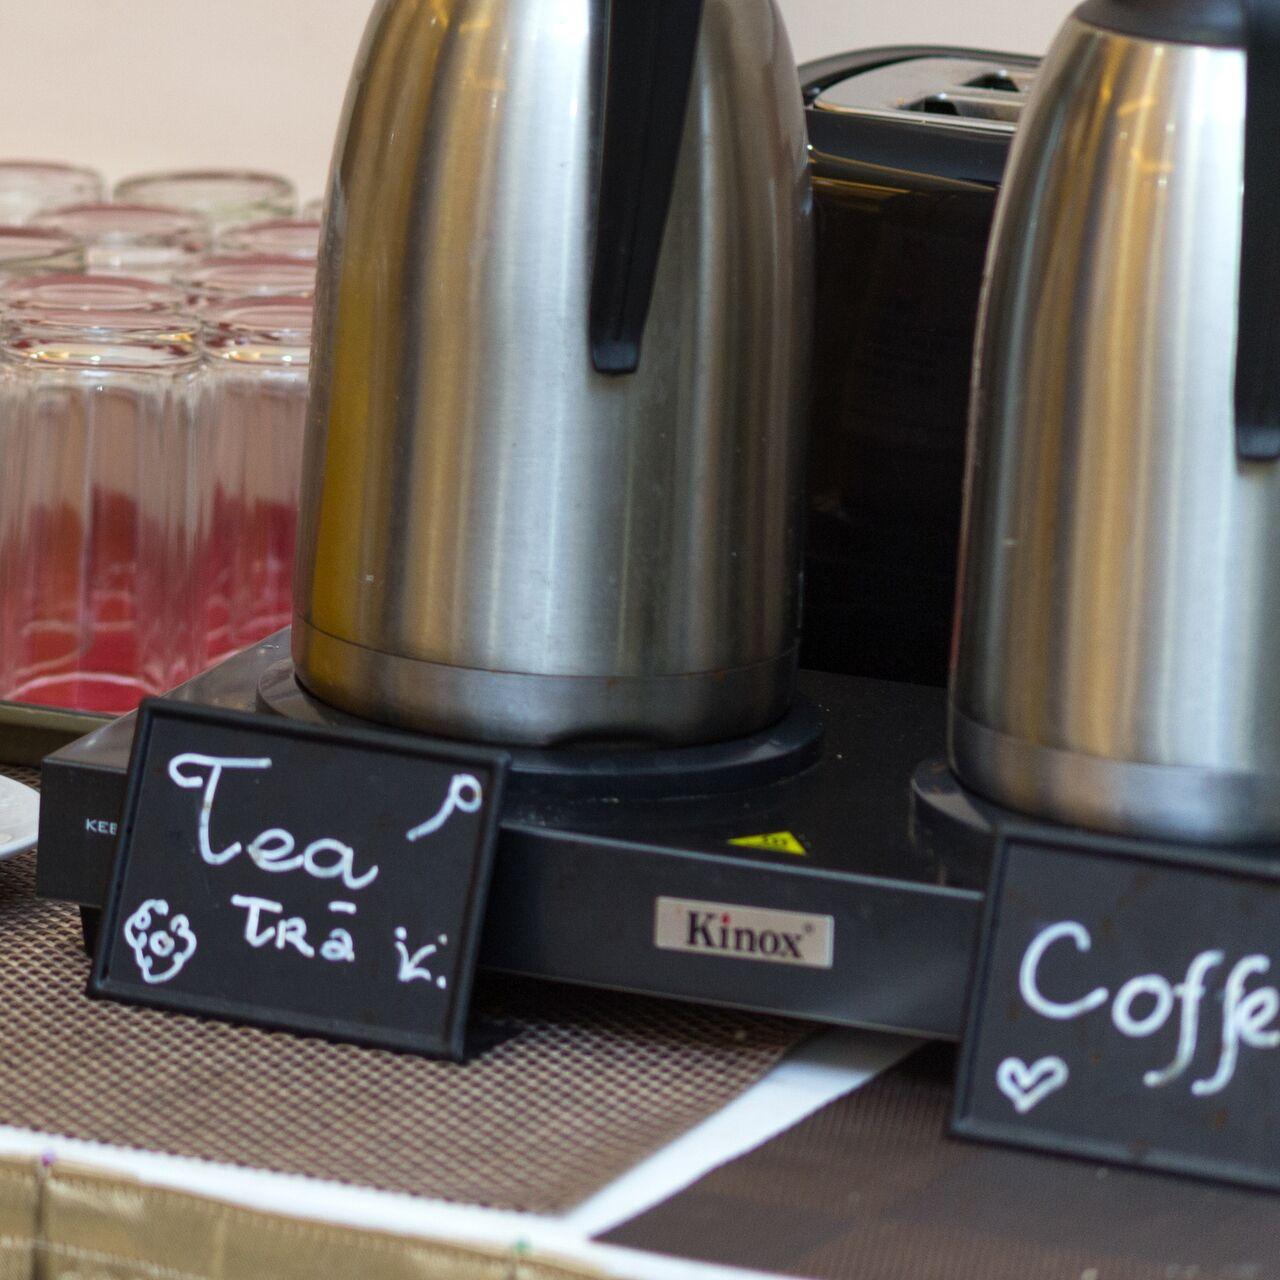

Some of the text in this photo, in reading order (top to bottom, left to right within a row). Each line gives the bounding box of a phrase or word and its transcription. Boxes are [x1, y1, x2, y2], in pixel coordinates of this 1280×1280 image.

[85, 818, 118, 835] KEE
[167, 752, 379, 890] Tea
[1018, 920, 1280, 1096] Coffe
